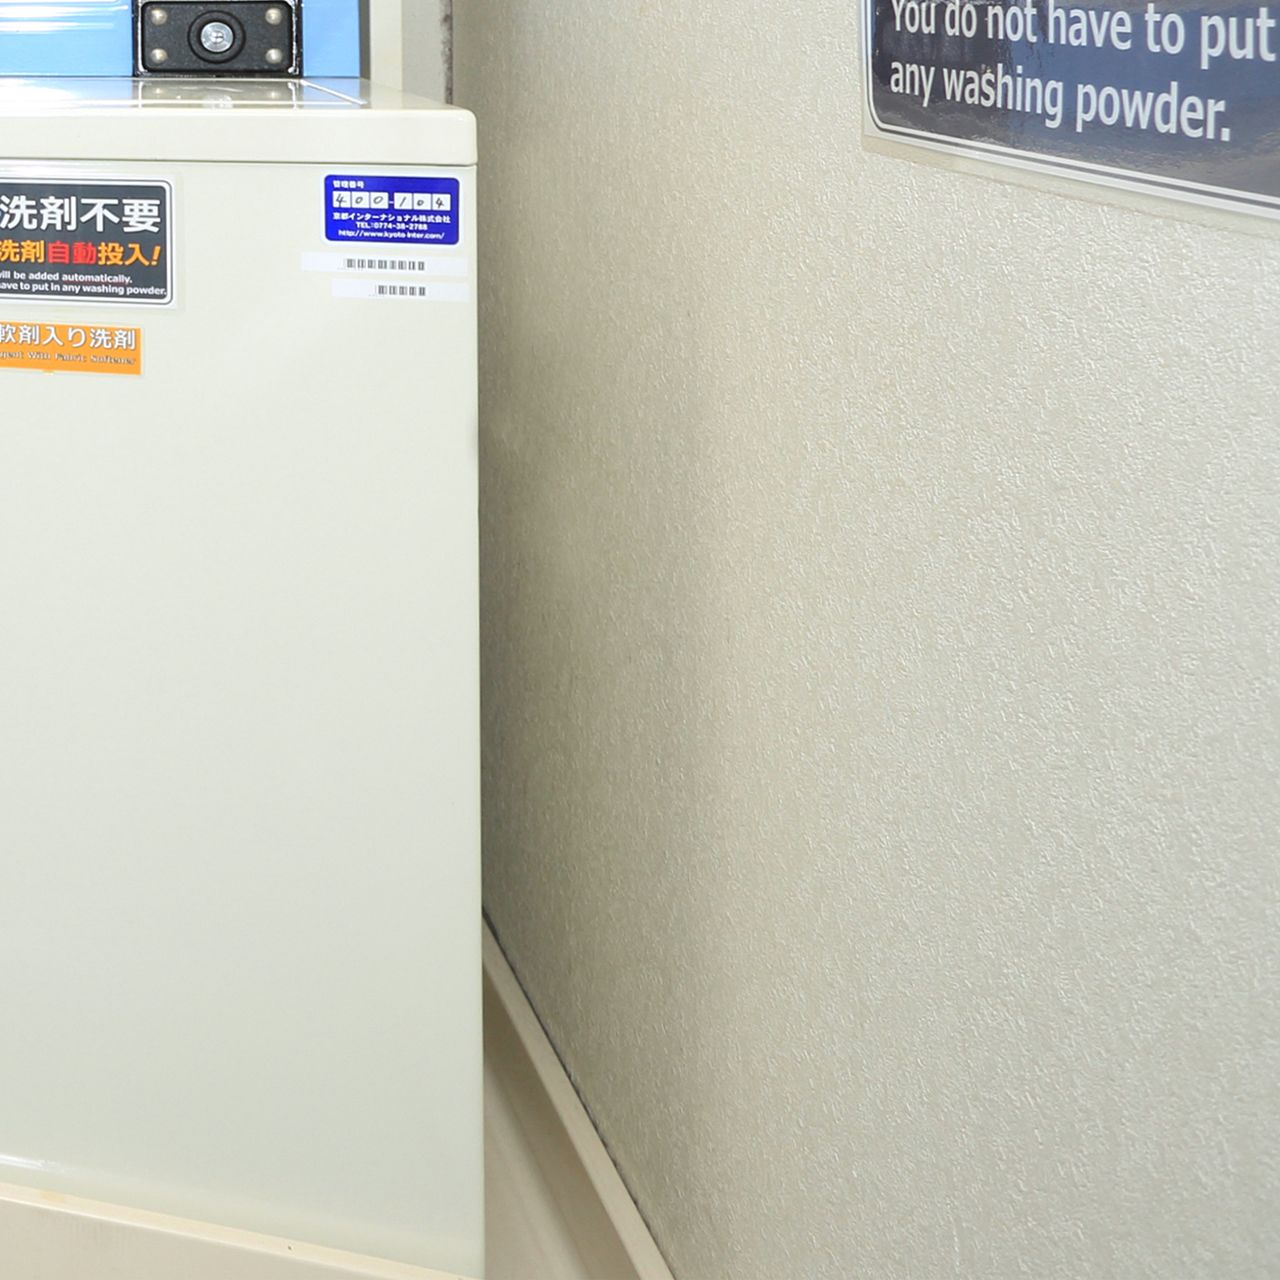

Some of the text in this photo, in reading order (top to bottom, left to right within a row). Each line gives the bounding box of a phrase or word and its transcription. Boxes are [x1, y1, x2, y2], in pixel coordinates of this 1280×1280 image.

[1145, 3, 1185, 54] to
[1200, 7, 1276, 70] put
[890, 60, 1232, 142] any washing powder.
[0, 194, 162, 233] 洗剤不要
[333, 212, 451, 224] 京都インターナショナル株式会社
[13, 270, 26, 280] be
[28, 271, 59, 281] added
[62, 272, 133, 285] automatically.
[20, 282, 30, 291] to
[32, 282, 49, 293] put
[50, 282, 61, 292] in
[62, 284, 80, 294] any
[83, 284, 124, 296] washing
[126, 286, 167, 297] powder.
